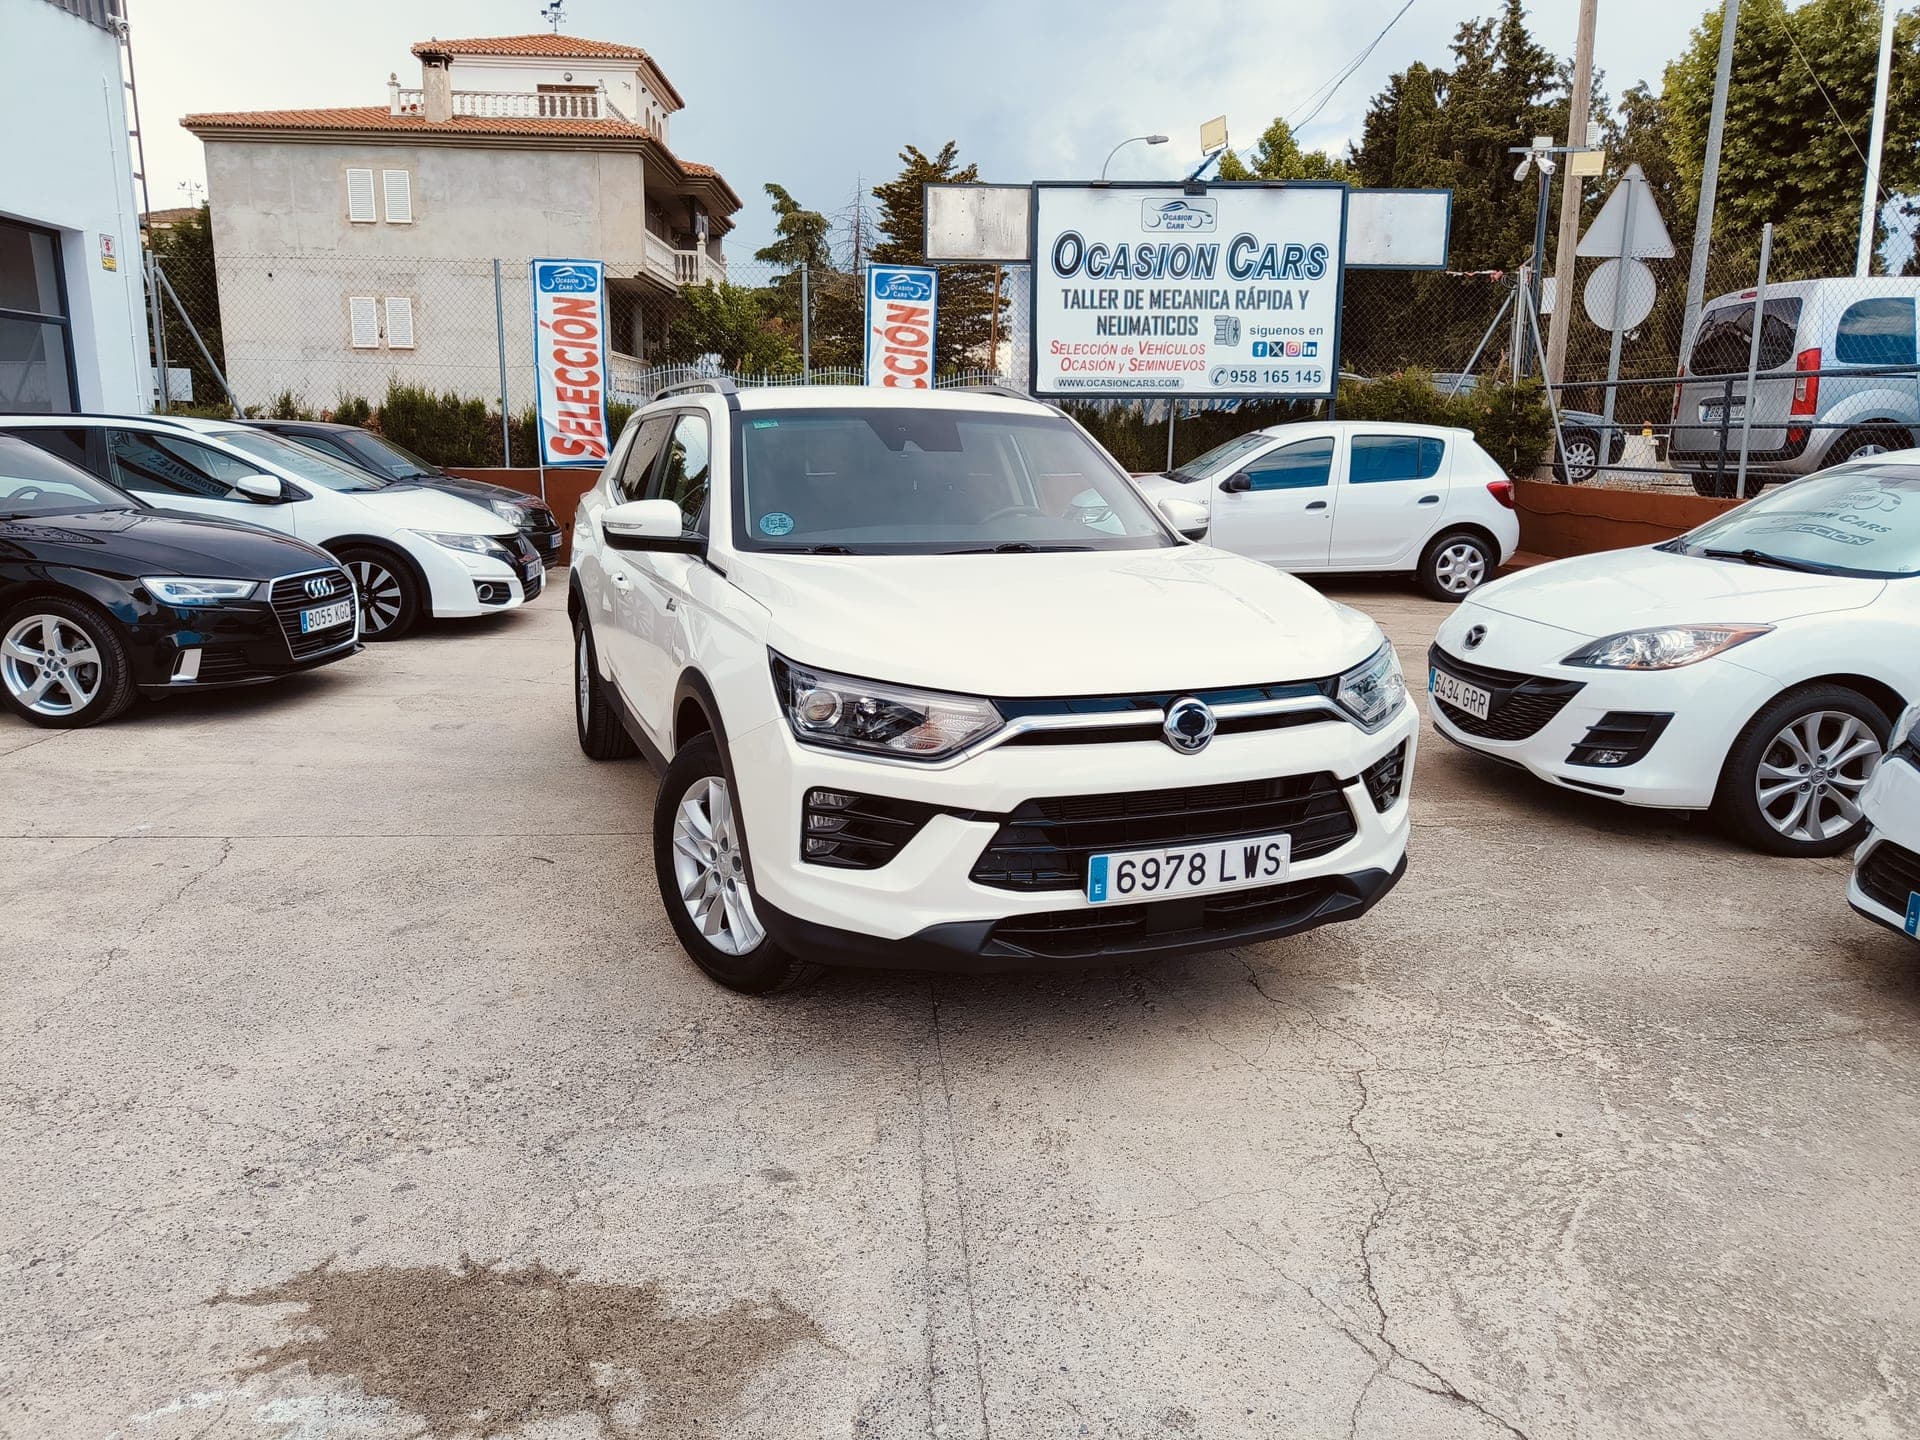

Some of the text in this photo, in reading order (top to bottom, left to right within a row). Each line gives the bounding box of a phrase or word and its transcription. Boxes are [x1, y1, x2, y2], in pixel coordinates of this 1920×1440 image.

[1051, 230, 1329, 281] OCASION CARS
[1061, 285, 1309, 310] TALLER DE MECANICA RÁPIDA Y
[1096, 315, 1199, 336] NEUMATICOS
[1249, 325, 1324, 337] siguenos en
[1050, 339, 1206, 355] SELECCIÓN de VEHÍCULOS
[540, 296, 606, 458] SELECCIÓN
[1060, 357, 1206, 374] OCASIÓN y SEMINUEVOS
[1230, 370, 1322, 383] 958 165 145
[1058, 379, 1180, 387] WWW.OCASIONCARS.COM
[308, 603, 349, 628] 8055 KGC
[1434, 673, 1487, 715] 6434 GRR
[1094, 843, 1281, 894] E 6978 LWS
